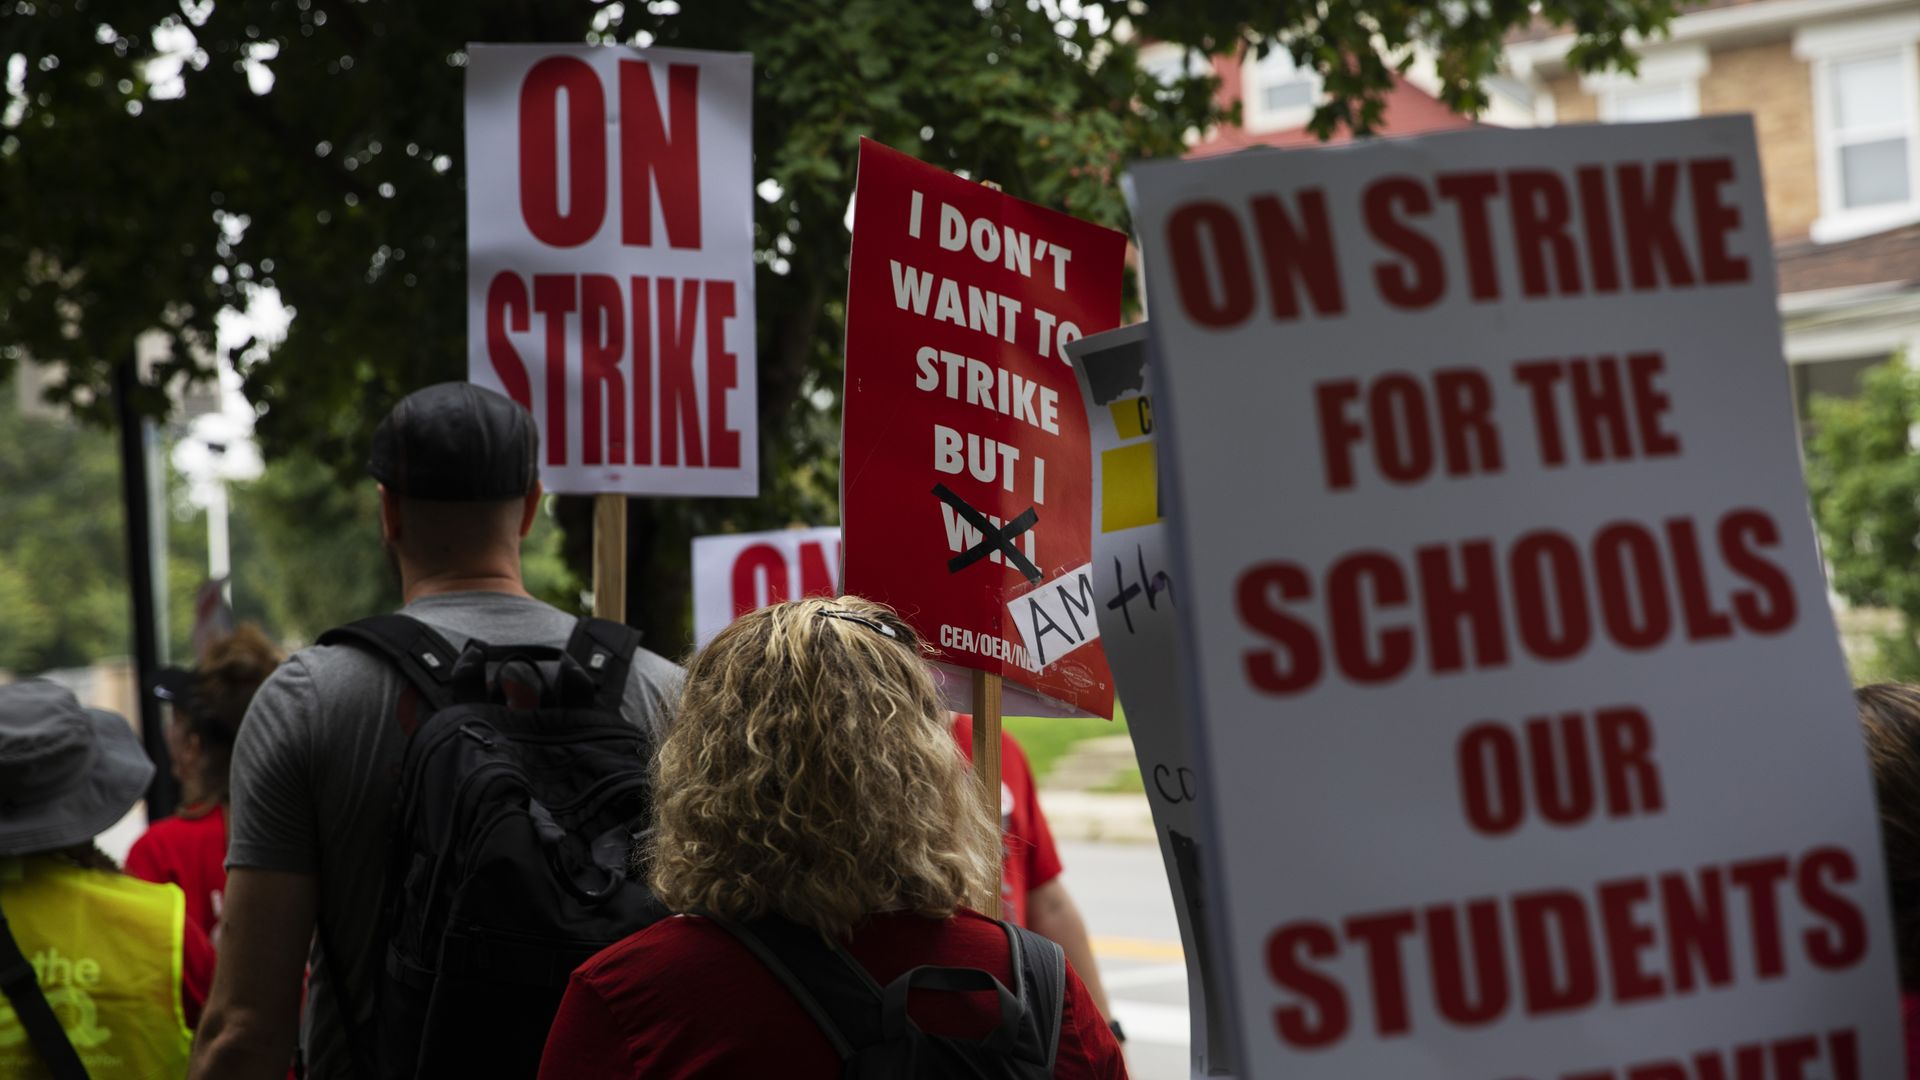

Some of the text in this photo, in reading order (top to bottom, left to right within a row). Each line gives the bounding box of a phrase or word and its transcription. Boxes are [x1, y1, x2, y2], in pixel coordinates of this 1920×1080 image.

[519, 55, 702, 250] ON
[890, 259, 1022, 344] WANT
[909, 190, 1072, 292] I DON'T
[1162, 154, 1753, 333] ON STRIKE
[486, 270, 741, 468] STRIKE
[915, 346, 1060, 436] STRIKE
[1313, 351, 1682, 495] FOR THE
[934, 423, 1045, 506] BUT I
[1028, 573, 1094, 666] AM
[1232, 506, 1800, 700] SCHOOLS
[1455, 704, 1666, 839] OUR
[1263, 845, 1870, 1053] STUDENTS
